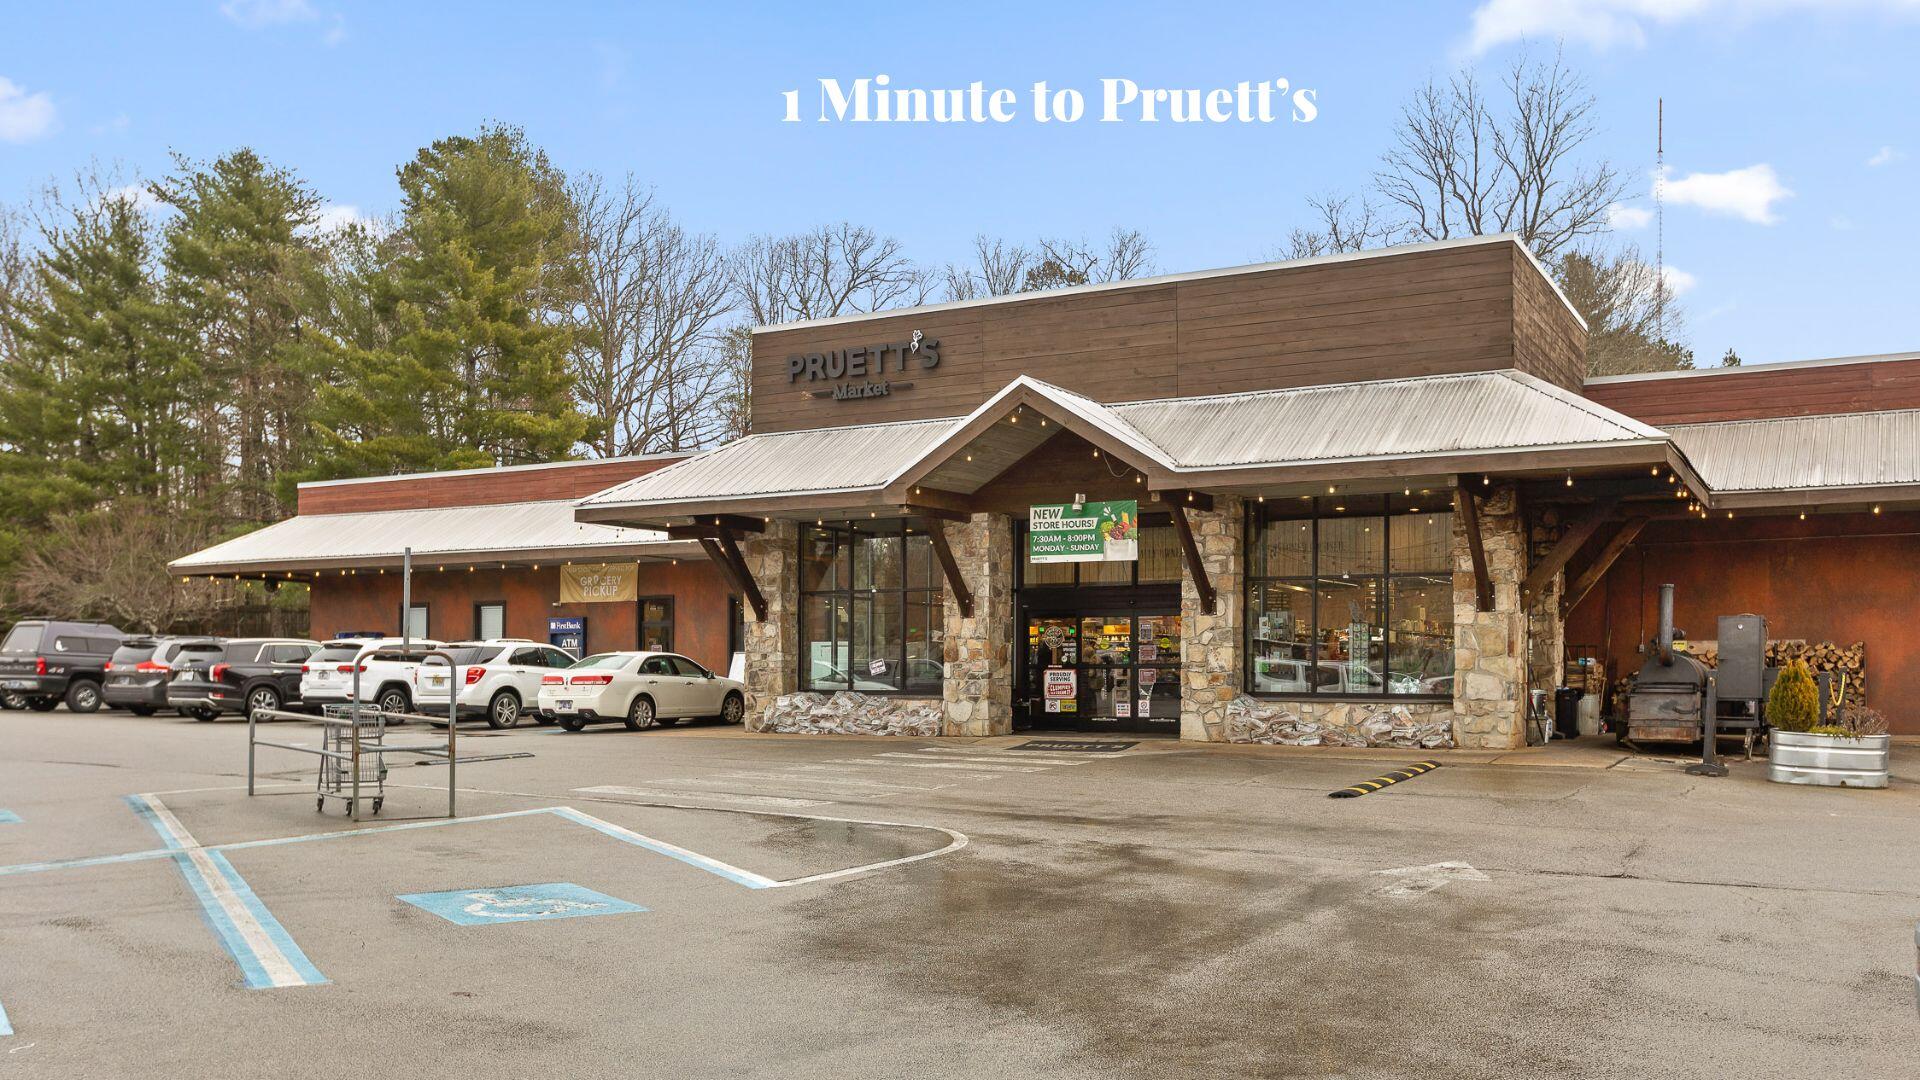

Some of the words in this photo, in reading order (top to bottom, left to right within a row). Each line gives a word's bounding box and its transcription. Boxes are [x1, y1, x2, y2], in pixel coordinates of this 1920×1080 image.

[832, 380, 889, 401] Market
[1033, 508, 1061, 520] NEW
[1033, 521, 1060, 530] STORE
[1062, 519, 1094, 529] HOURS!
[1033, 535, 1061, 543] 7:30AM
[1067, 534, 1096, 542] 8:00PM
[1070, 543, 1099, 551] SUNDAY
[580, 575, 621, 586] GROCERY
[583, 585, 618, 597] PICKUP
[561, 639, 578, 647] ATM
